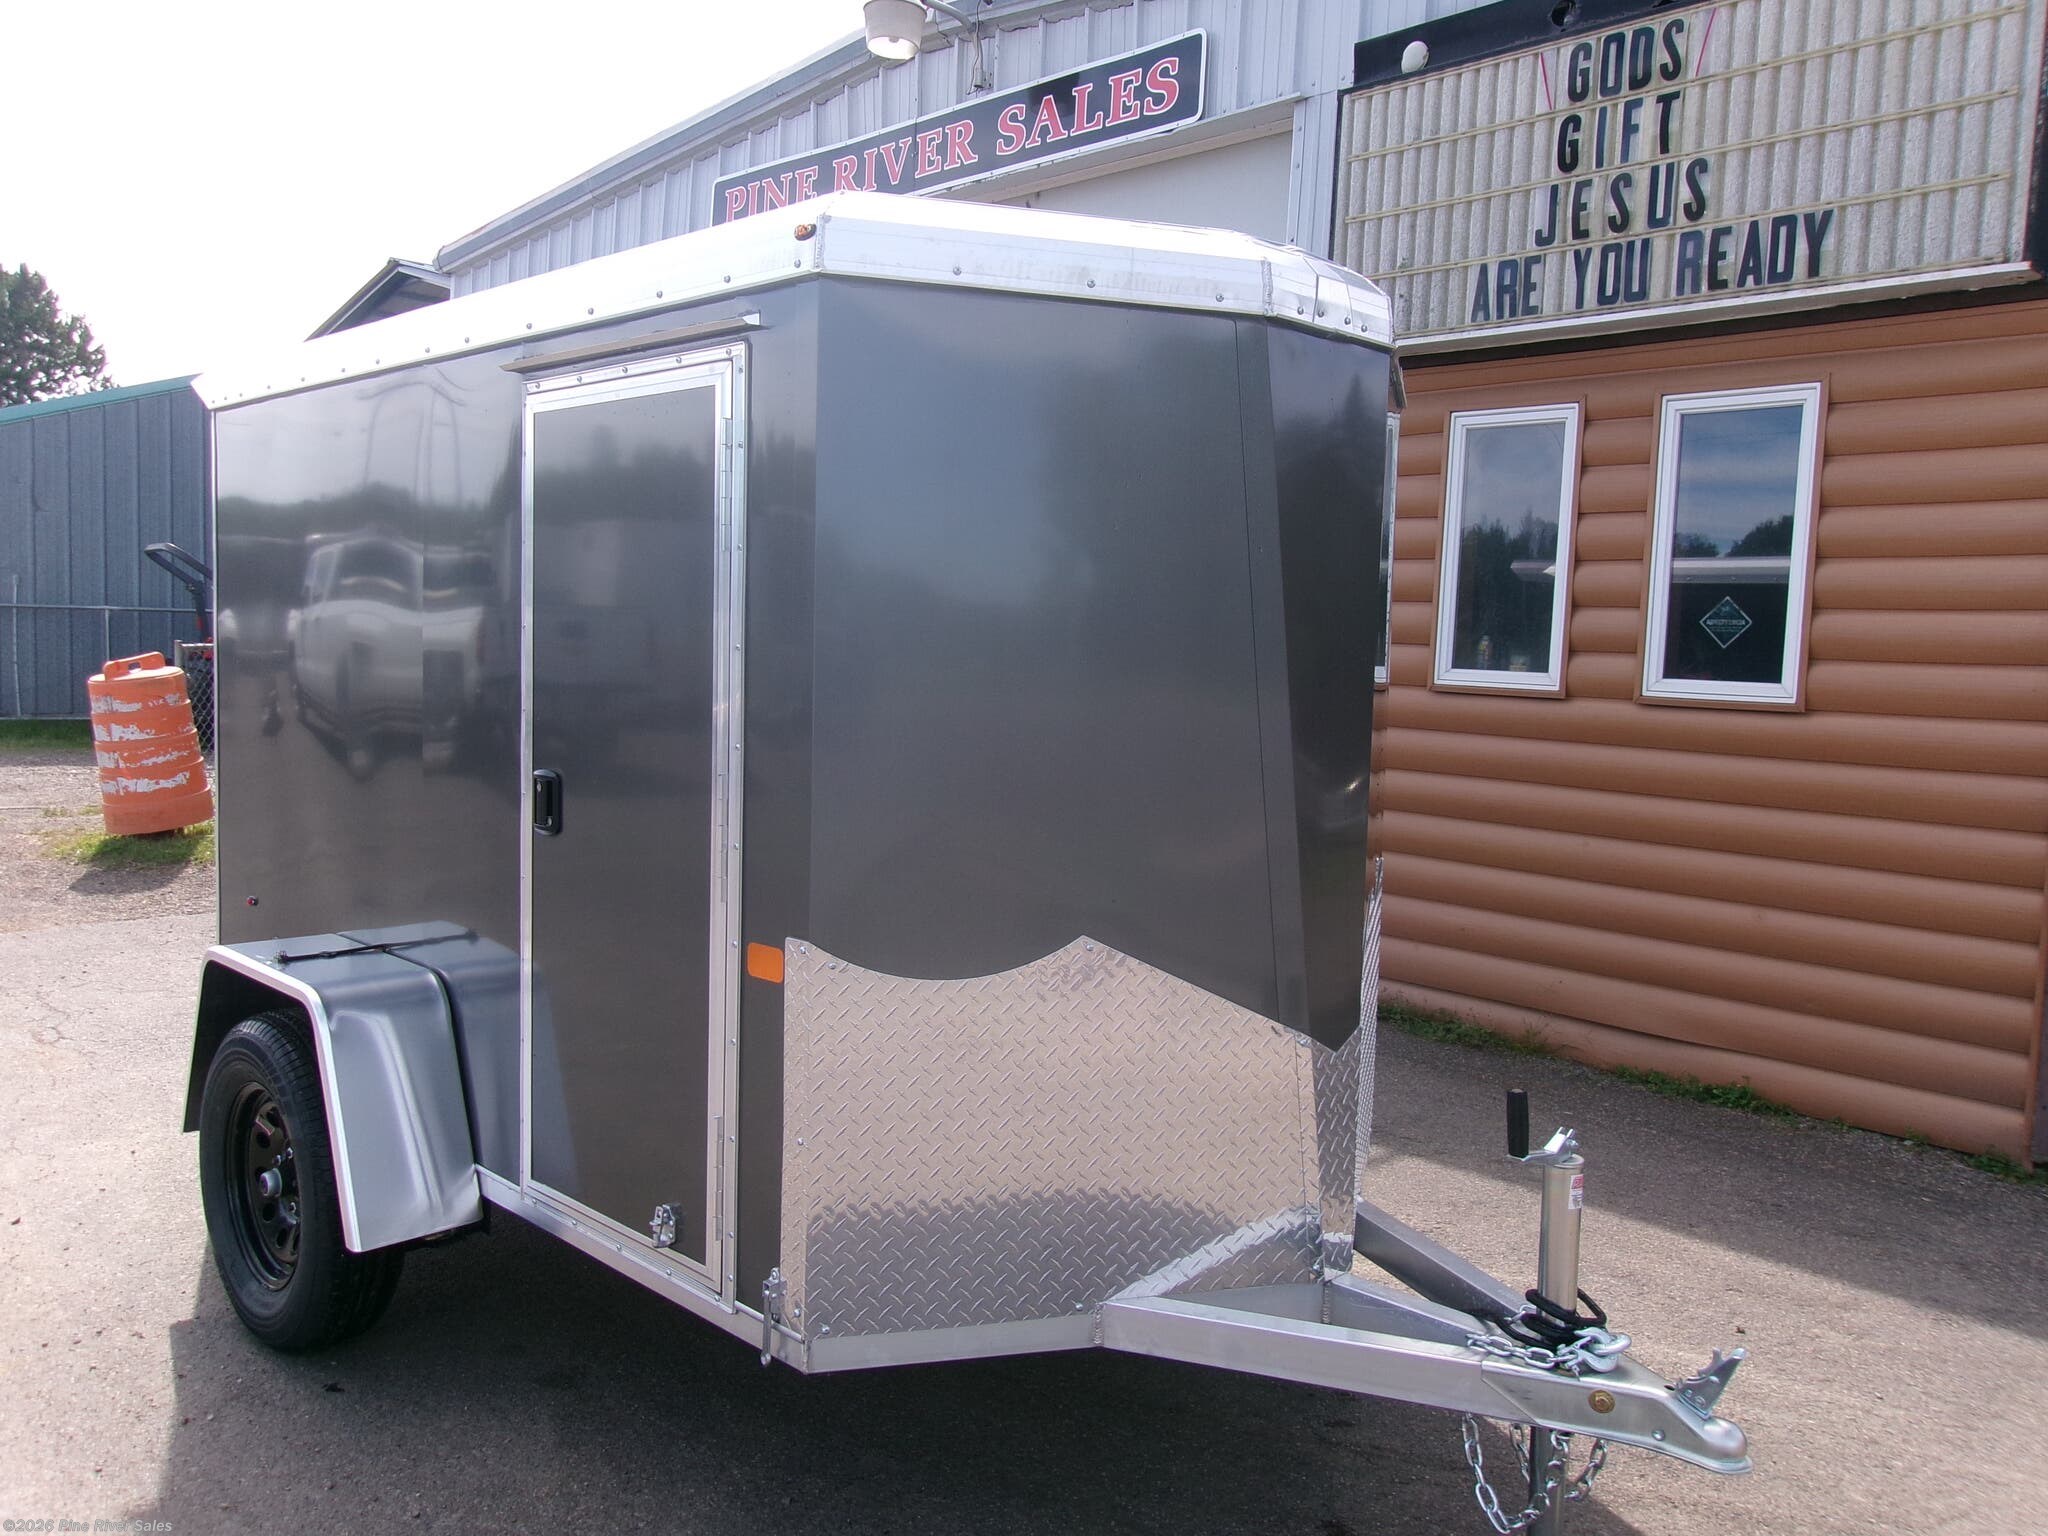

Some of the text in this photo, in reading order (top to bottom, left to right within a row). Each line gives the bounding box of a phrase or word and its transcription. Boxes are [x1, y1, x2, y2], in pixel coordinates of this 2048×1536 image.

[1567, 19, 1684, 102] GODS
[725, 57, 1180, 222] PINE RIVER SALES
[1557, 91, 1681, 174] GIFT
[1534, 158, 1708, 247] JESUS
[1471, 209, 1834, 323] ARE YOU READY
